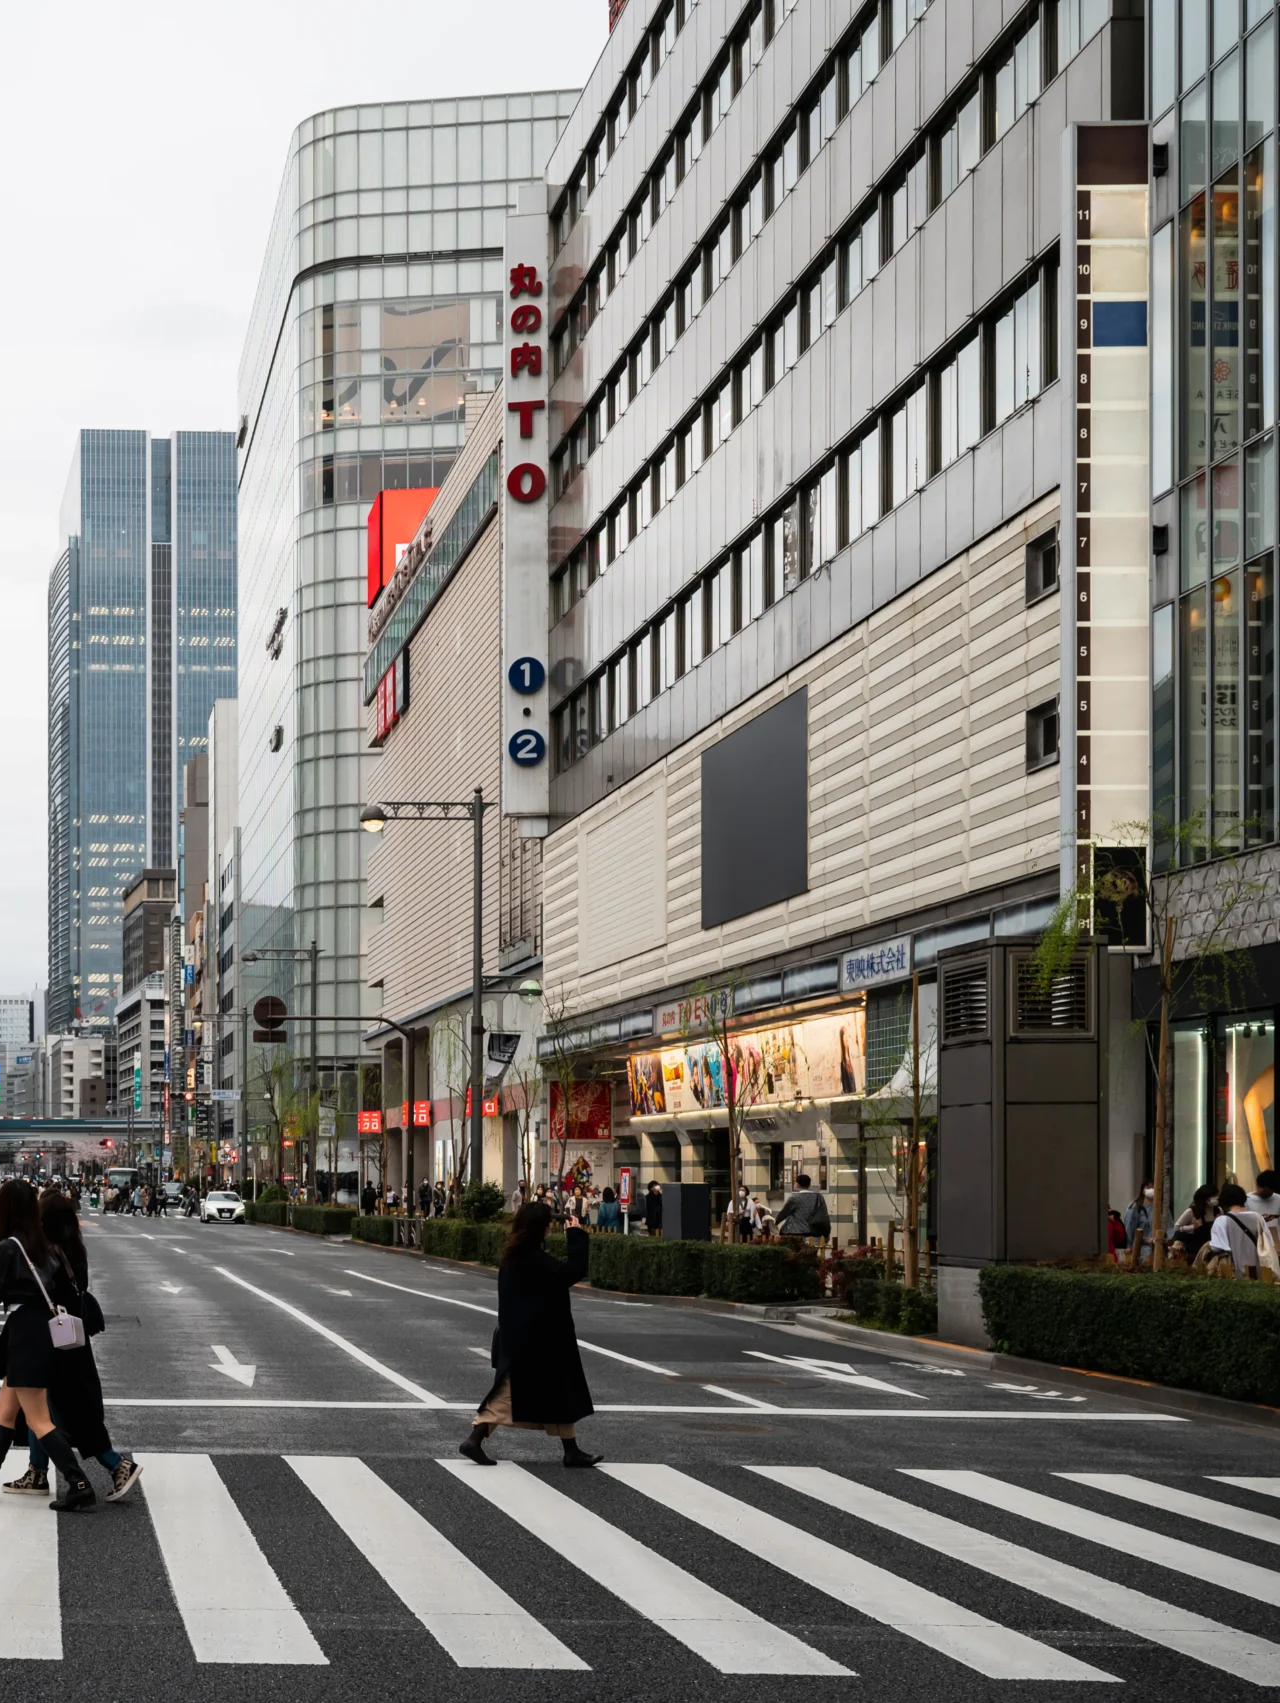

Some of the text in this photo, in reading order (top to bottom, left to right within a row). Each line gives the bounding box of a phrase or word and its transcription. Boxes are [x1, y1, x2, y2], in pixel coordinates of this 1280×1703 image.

[1078, 210, 1090, 220] 11
[1078, 265, 1090, 275] 10
[1080, 319, 1088, 329] 9
[1080, 374, 1087, 384] 8
[1080, 428, 1087, 438] 8
[1080, 482, 1087, 492] 7
[1080, 537, 1087, 547] 7
[1080, 592, 1087, 602] 6
[1080, 646, 1087, 656] 5
[1080, 701, 1087, 711] 5
[1080, 755, 1087, 765] 4
[1081, 810, 1086, 819] 1
[845, 944, 907, 984] 東映株式会社
